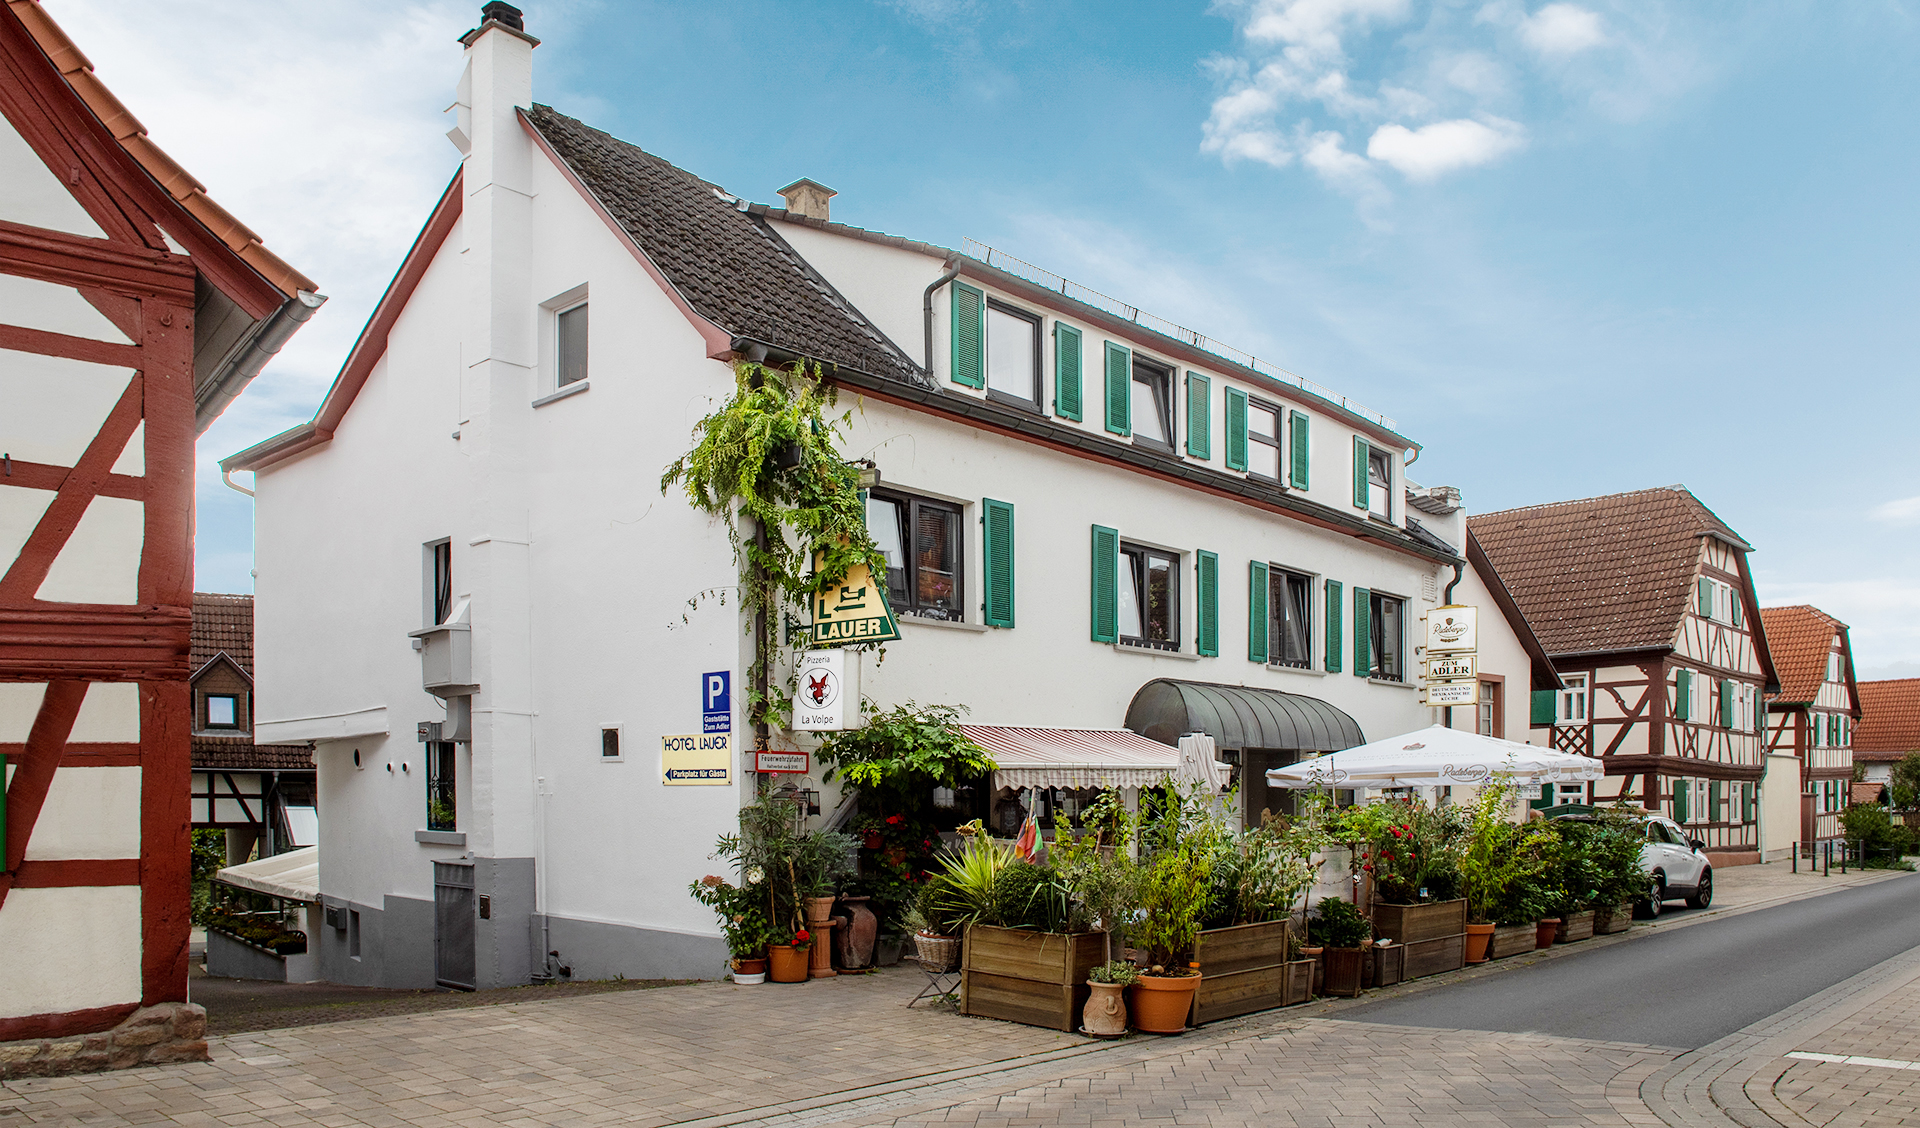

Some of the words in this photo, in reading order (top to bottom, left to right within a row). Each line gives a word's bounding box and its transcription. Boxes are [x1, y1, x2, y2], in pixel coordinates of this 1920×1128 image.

[817, 618, 881, 640] LAUER
[807, 656, 831, 664] Pizzeria
[1431, 666, 1469, 675] ADLER
[709, 675, 724, 709] P
[704, 715, 730, 723] Gaststätte
[801, 715, 810, 724] La
[812, 714, 834, 725] Volpe
[704, 723, 716, 731] Zum
[716, 722, 730, 730] Adler
[664, 737, 697, 751] HOTEL
[699, 736, 728, 750] LAUER
[761, 754, 804, 763] Feuerwehrzufahrt
[673, 770, 699, 779] Parkplatz
[699, 769, 708, 777] für
[708, 769, 726, 777] Gäste
[1442, 764, 1487, 781] Radeberger
